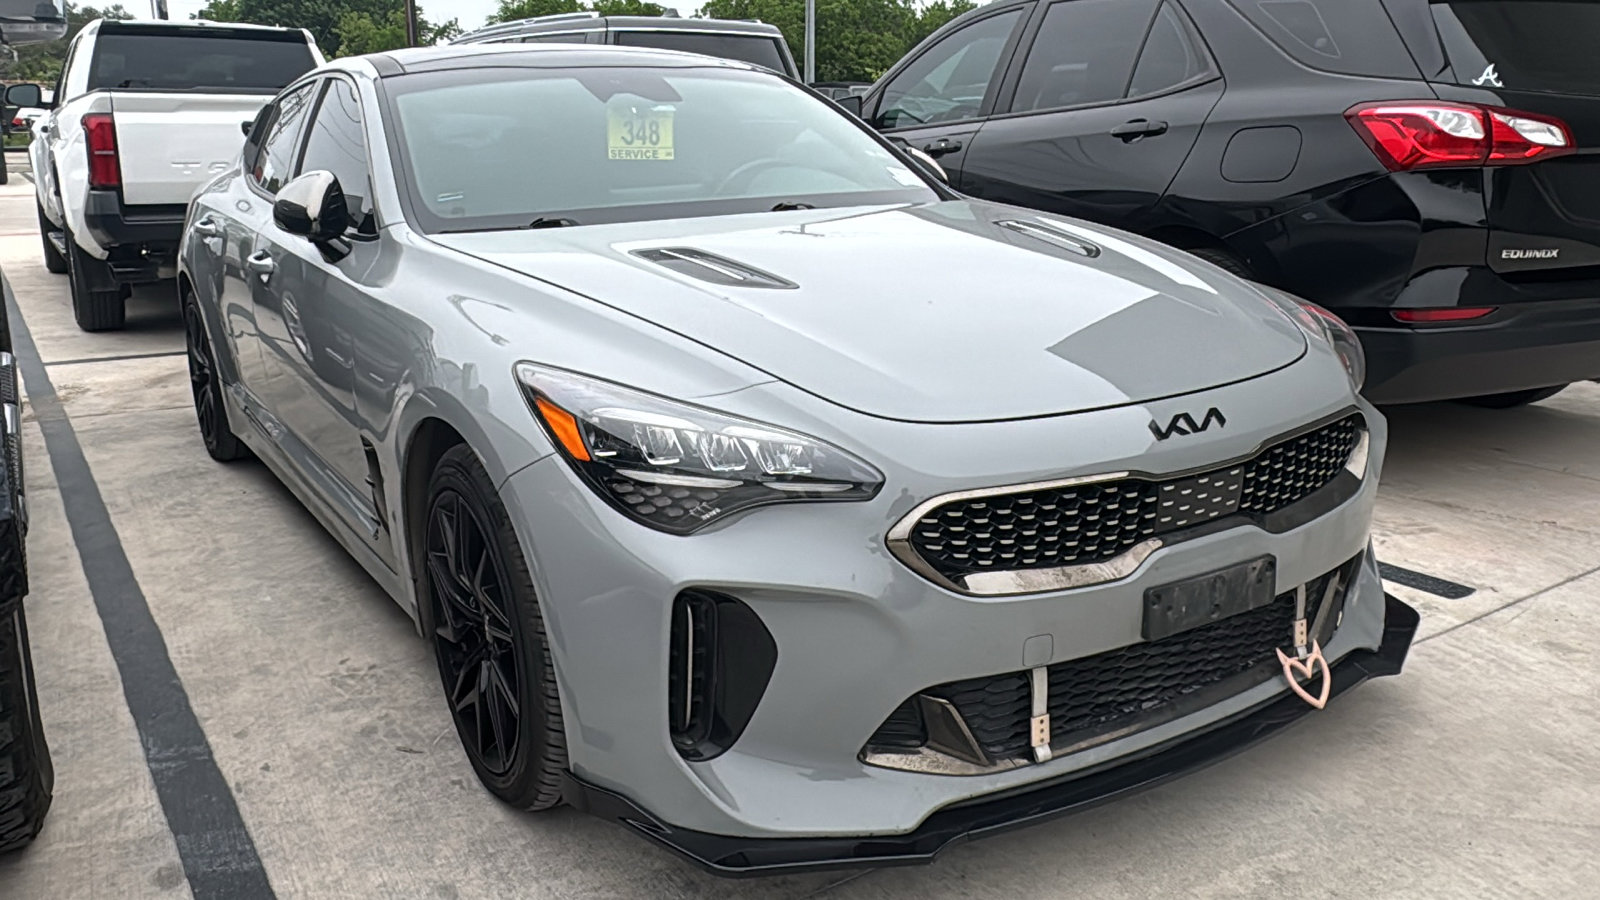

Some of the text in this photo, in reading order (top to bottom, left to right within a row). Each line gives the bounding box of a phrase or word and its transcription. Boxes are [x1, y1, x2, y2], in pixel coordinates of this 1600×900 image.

[621, 120, 660, 146] 348
[610, 149, 659, 159] SERVICE
[1501, 248, 1560, 259] EQUINOX
[1148, 407, 1226, 442] KIA
